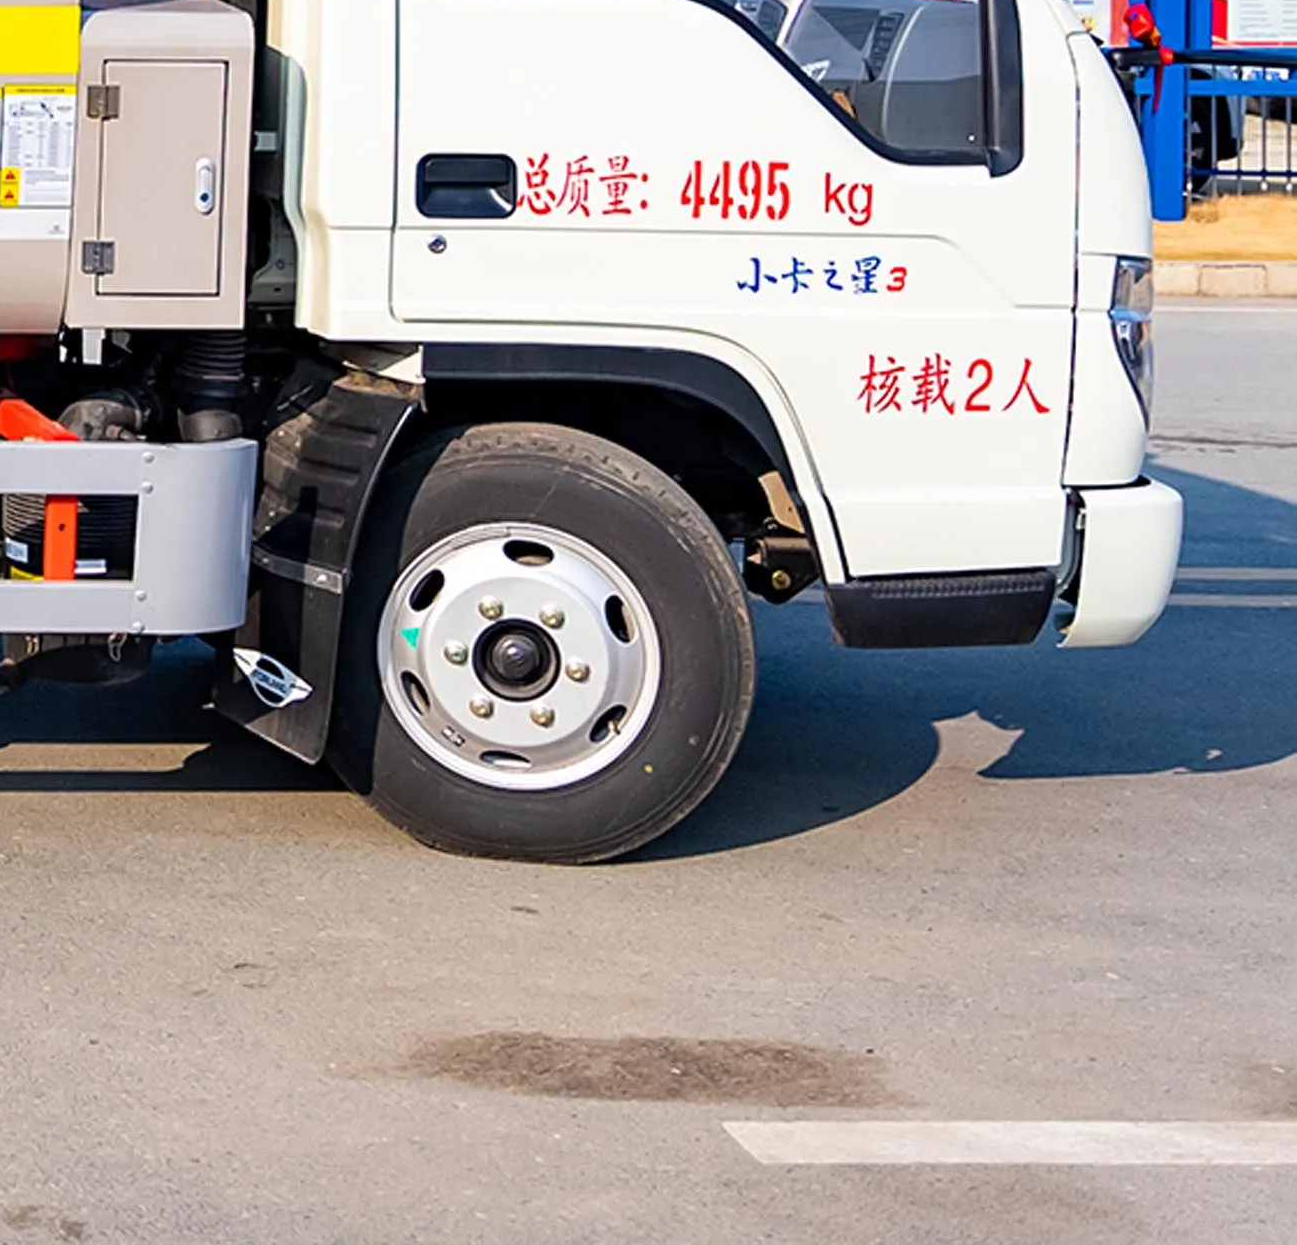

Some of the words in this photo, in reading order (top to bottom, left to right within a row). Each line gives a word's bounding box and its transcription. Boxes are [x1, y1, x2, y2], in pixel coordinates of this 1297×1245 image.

[679, 160, 791, 220] 4495
[824, 172, 874, 226] kg
[859, 353, 1051, 415] 核载2人
